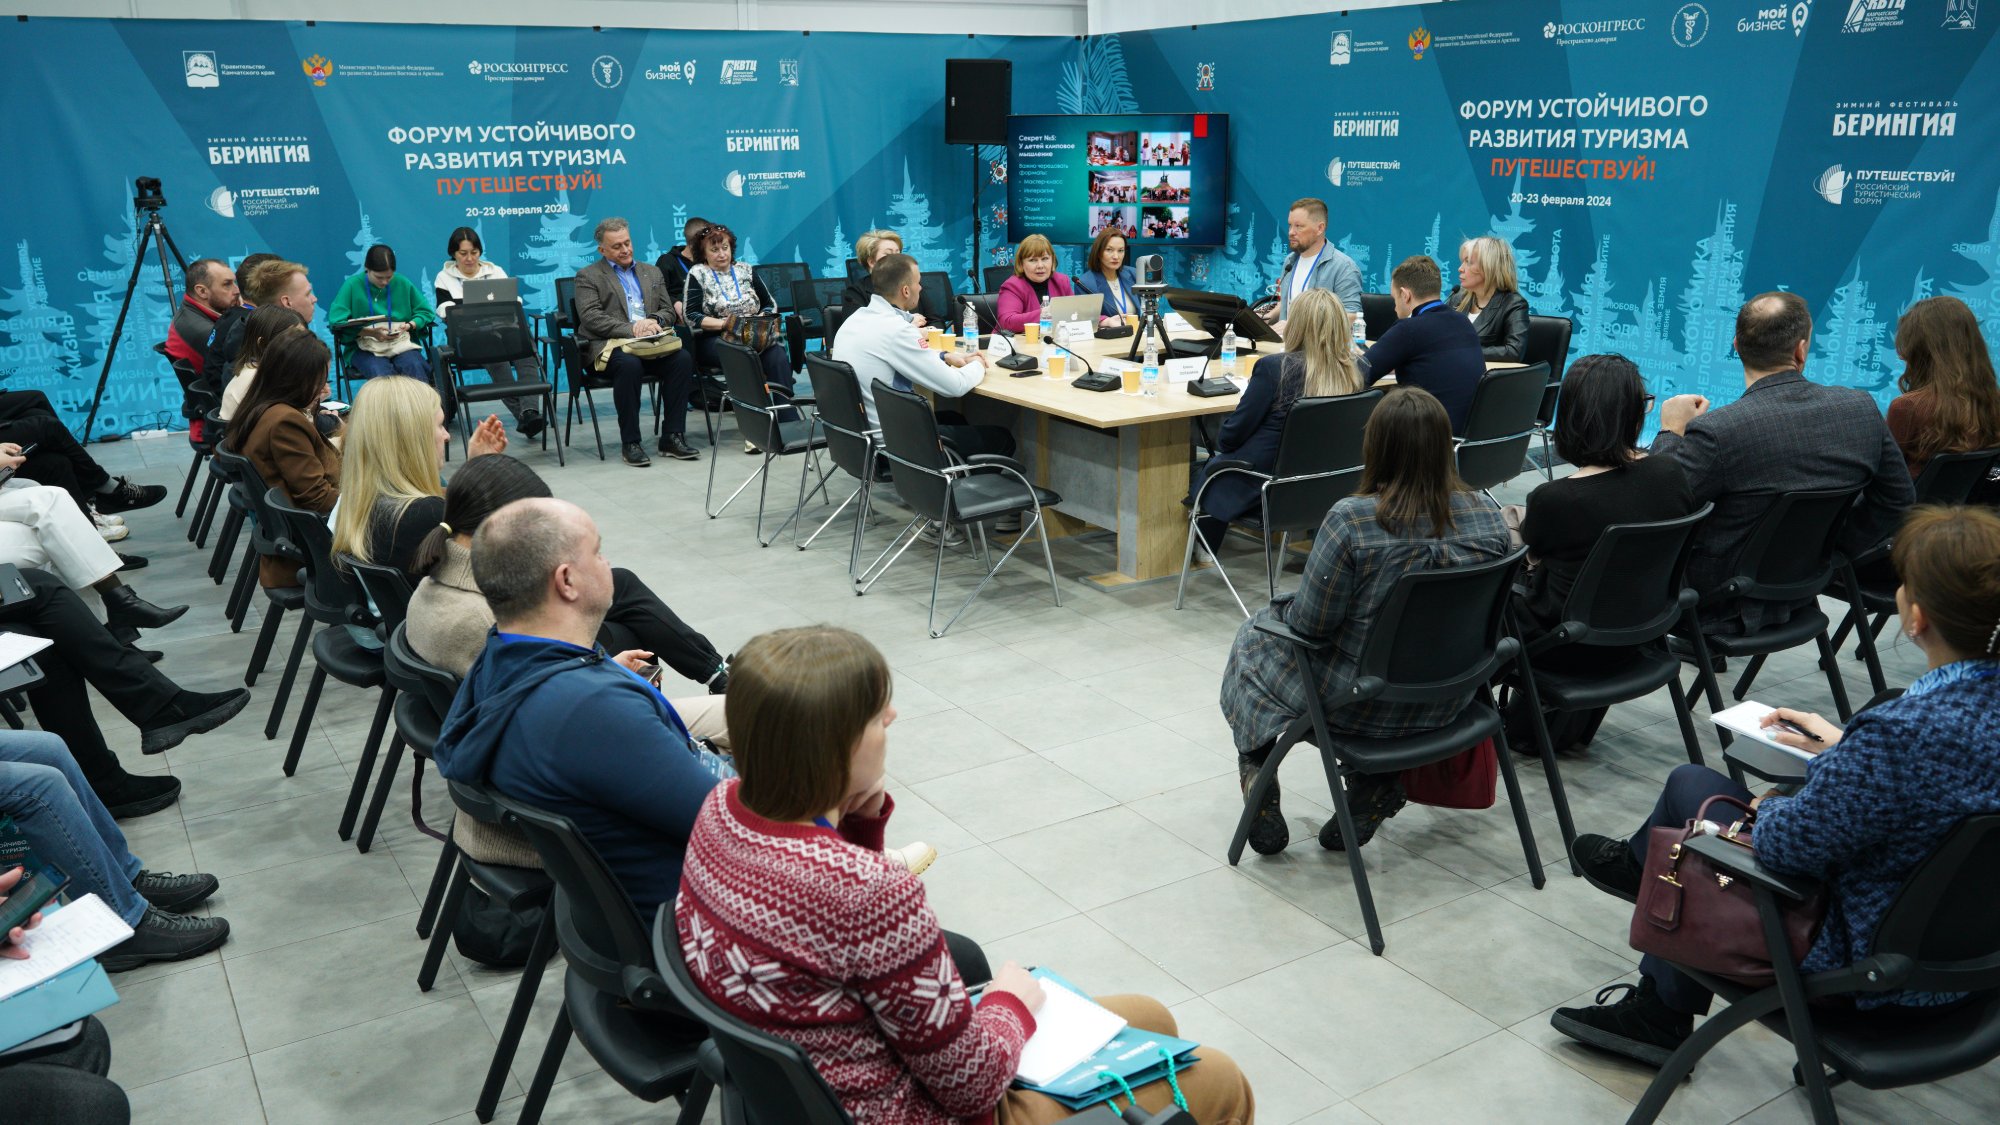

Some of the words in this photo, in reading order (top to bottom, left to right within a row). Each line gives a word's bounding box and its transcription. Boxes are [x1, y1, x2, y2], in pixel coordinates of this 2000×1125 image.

[1758, 4, 1787, 20] мой
[1557, 18, 1646, 36] РОСКОНГРЕСС
[1737, 18, 1786, 32] бизнес
[484, 63, 569, 73] РОСКОНГРЕСС
[645, 70, 681, 80] бизнес
[660, 61, 681, 72] мой
[1460, 99, 1533, 120] ФОРУМ
[1538, 92, 1708, 119] УСТОЙЧИВОГО
[1836, 100, 1881, 108] ЗИМНИЙ
[1889, 100, 1958, 108] ФЕСТИВАЛЬ
[387, 125, 472, 144] ФОРУМ
[477, 121, 636, 143] УСТОЙЧИВОГО
[1333, 119, 1399, 137] БЕРИНГИЯ
[1832, 112, 1957, 136] БЕРИНГИЯ
[726, 135, 800, 152] БЕРИНГИЯ
[1019, 135, 1042, 143] Секрет
[1468, 129, 1576, 148] РАЗВИТИЯ
[1582, 128, 1689, 149] ТУРИЗМА
[208, 144, 311, 165] БЕРИНГИЯ
[405, 150, 523, 170] РАЗВИТИЯ
[527, 148, 627, 167] ТУРИЗМА
[1347, 159, 1400, 170] ПУТЕШЕСТВУЙ!
[1491, 155, 1656, 181] ПУТЕШЕСТВУЙ!
[437, 169, 603, 195] ПУТЕШЕСТВУЙ!
[748, 169, 806, 180] ПУТЕШЕСТВУЙ!
[1856, 169, 1955, 182] ПУТЕШЕСТВУЙ!
[241, 185, 320, 198] ПУТЕШЕСТВУЙ!
[1854, 190, 1922, 199] ТУРИСТИЧЕСКИЙ
[1855, 182, 1910, 191] РОССИЙСКИЙ
[243, 202, 299, 210] ТУРИСТИЧЕСКИЙ
[1511, 193, 1538, 204] 20-23
[1541, 193, 1584, 207] февраля
[1586, 195, 1611, 207] 2024
[465, 207, 495, 217] 20-23
[497, 206, 543, 218] февраля
[544, 204, 568, 214] 2024
[1549, 228, 1562, 280] ЗАБОТА
[1716, 203, 1738, 307] ВПЕЧАТЛЕНИЯ
[1952, 243, 1991, 255] ЗЕМЛЯ
[32, 257, 48, 310] РАЗВИТИЕ
[77, 269, 126, 282] СЕМЬЯ
[1727, 249, 1744, 307] ЗАБОТА
[1528, 282, 1561, 296] ВОДА
[1683, 237, 1710, 367] ЭКОНОМИКА
[0, 316, 57, 331] ЗЕМЛЯ
[1603, 323, 1640, 339] ВОДА
[1643, 300, 1655, 352] ЧУВСТВА
[10, 332, 44, 343] ВОДА
[1602, 337, 1638, 352] ЖИЗНЬ
[1823, 286, 1849, 387] КОНОМИКА
[1856, 301, 1876, 384] УСТОЙЧИВОЕ
[0, 342, 59, 364] ЮДИ
[60, 315, 84, 381] ЖИЗНЬ
[1841, 318, 1861, 382] ЧЕЛОВЕК
[1869, 321, 1888, 385] РАЗВИТИЕ
[3, 373, 63, 390] СЕМЬЯ
